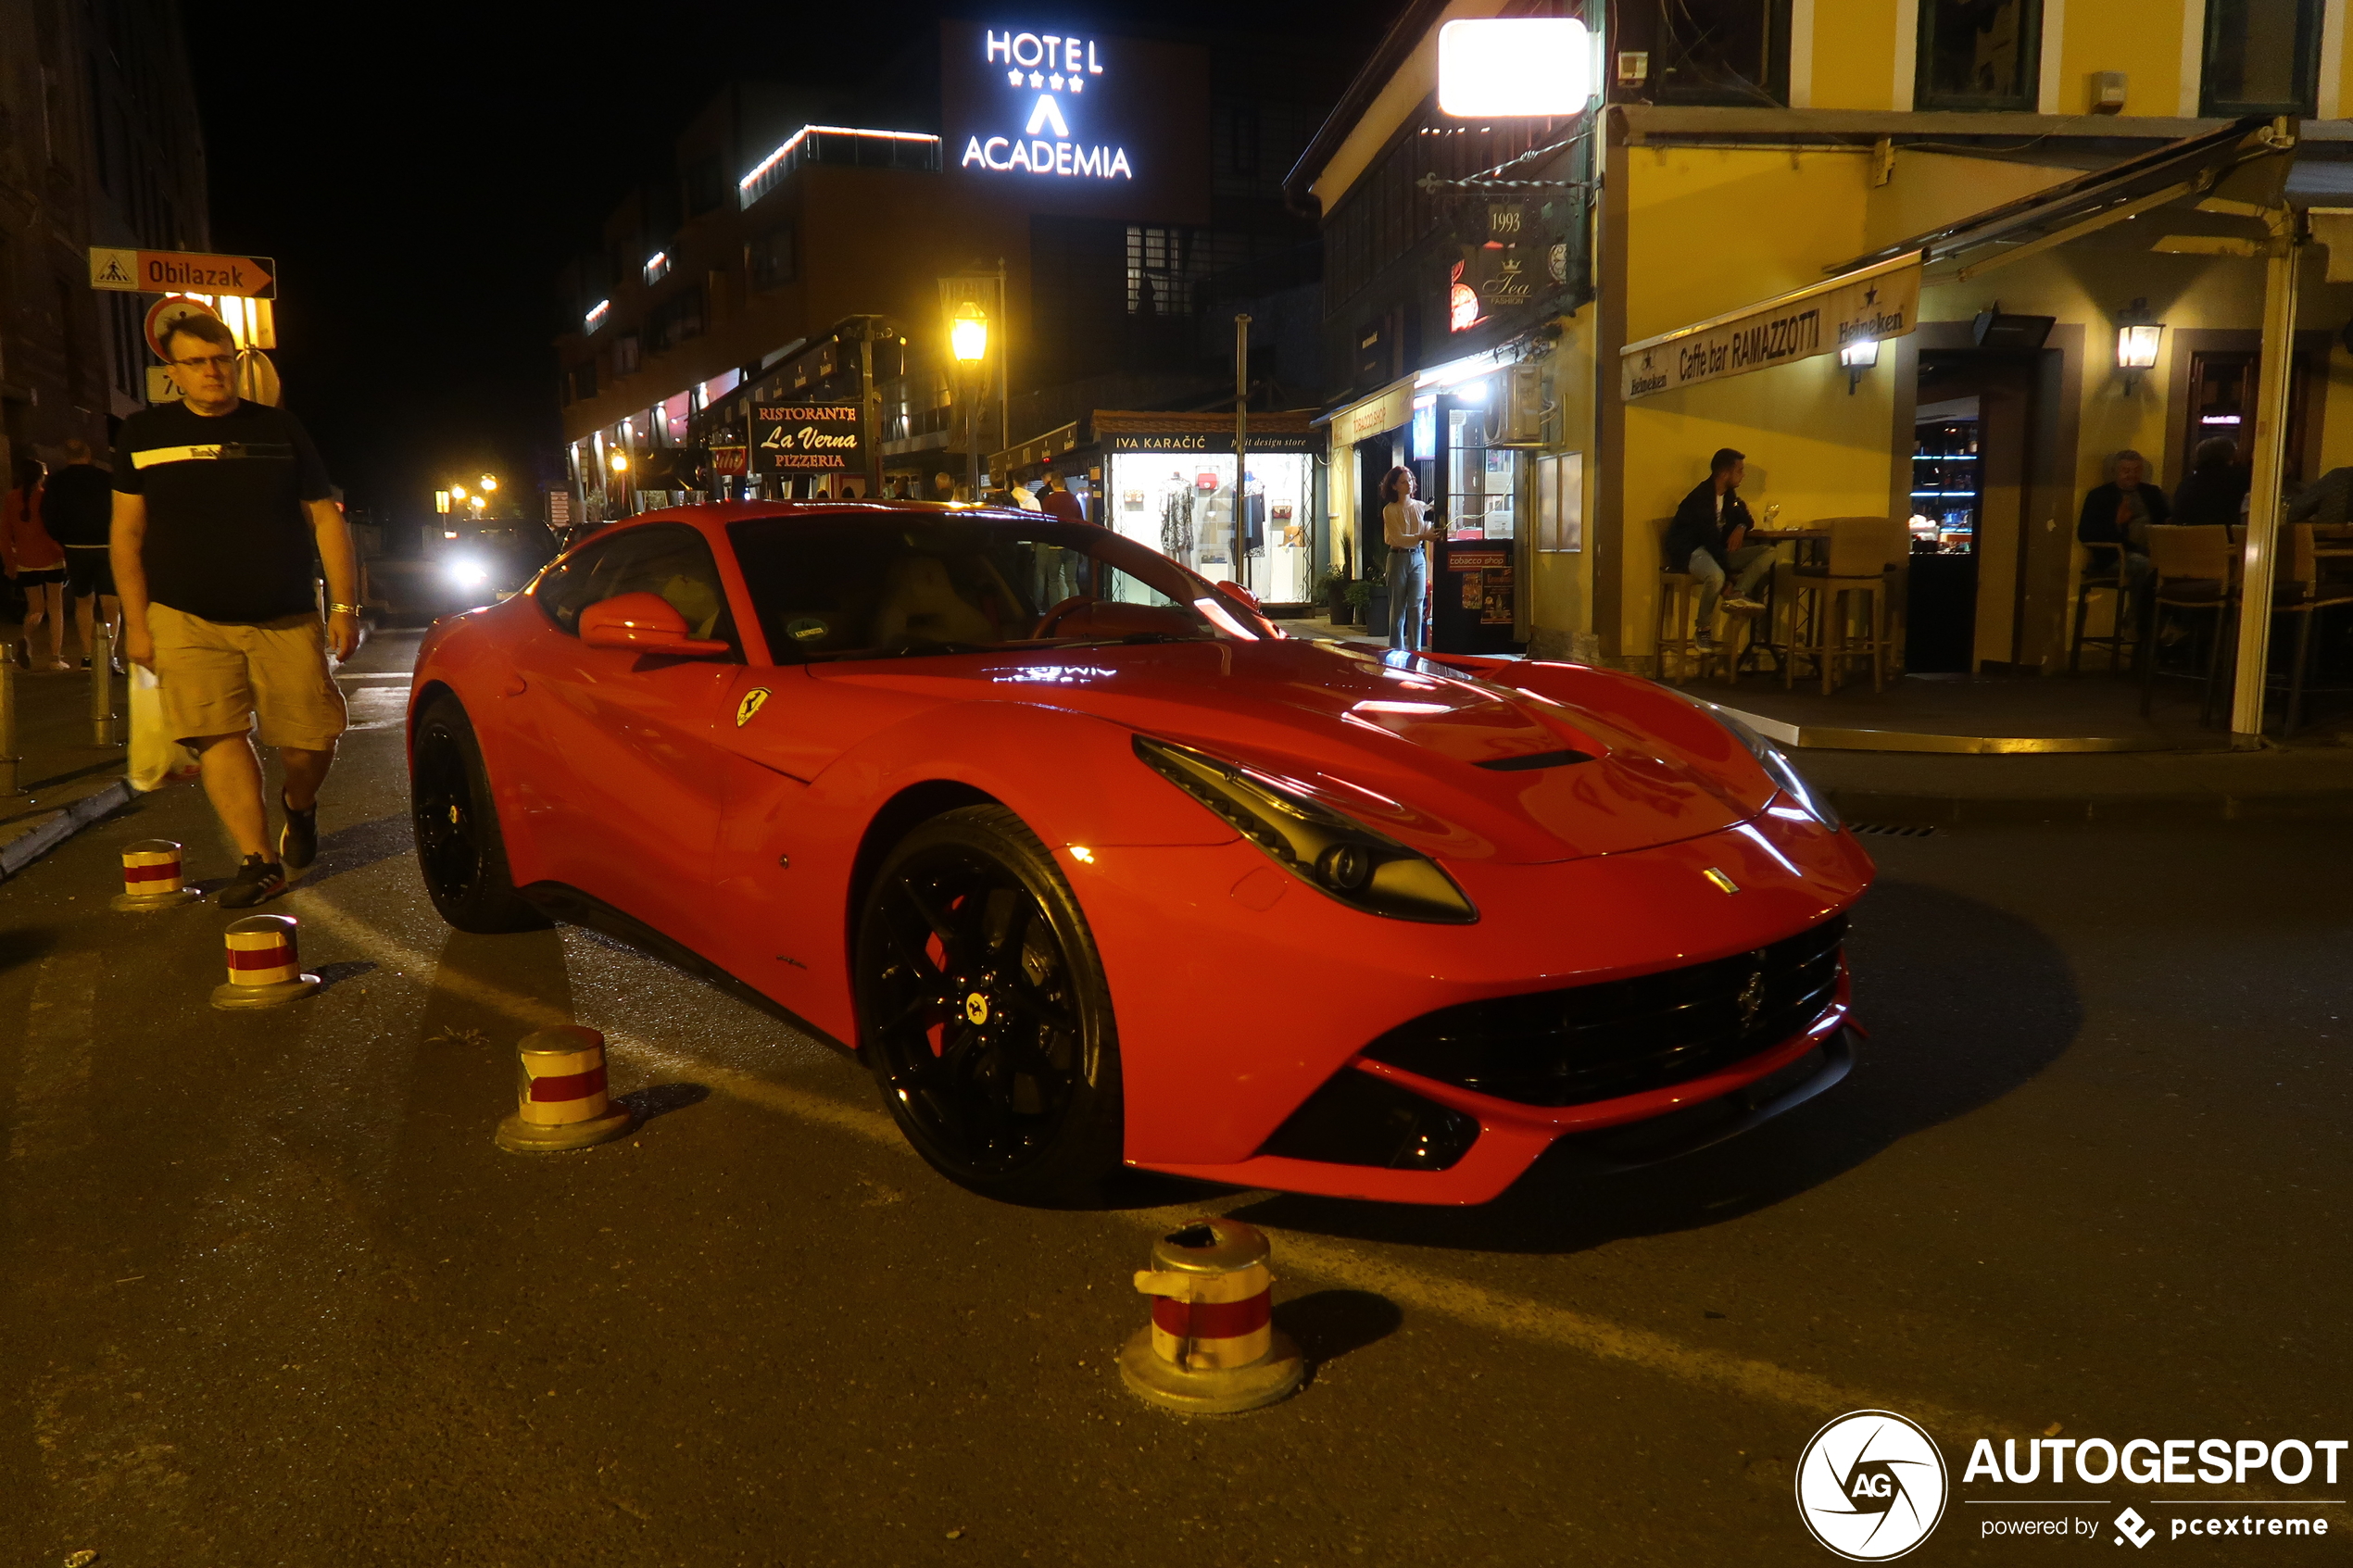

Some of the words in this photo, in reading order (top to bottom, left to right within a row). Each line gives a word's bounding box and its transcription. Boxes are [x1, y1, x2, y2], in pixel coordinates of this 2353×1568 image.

[987, 29, 1103, 75] HOTEL
[962, 135, 1132, 180] ACADEMIA
[1491, 212, 1521, 232] 1993
[149, 259, 244, 288] Obilazak
[1481, 270, 1530, 295] Tea
[1491, 296, 1524, 305] FASHION
[1838, 311, 1904, 345] Heineken
[1680, 346, 1706, 382] Caffe
[1709, 342, 1729, 375] bar
[1731, 308, 1820, 370] RAMAZZOTTI
[759, 407, 856, 422] RISTORANTE
[761, 425, 795, 449] La
[798, 426, 858, 449] Verna
[1115, 437, 1139, 448] IVA
[1143, 435, 1206, 448] KARAČIĆ
[1253, 437, 1282, 448] design
[1284, 438, 1306, 446] store
[774, 454, 845, 468] PIZZERIA
[1449, 557, 1482, 565] tobacco
[1484, 557, 1504, 565] shop
